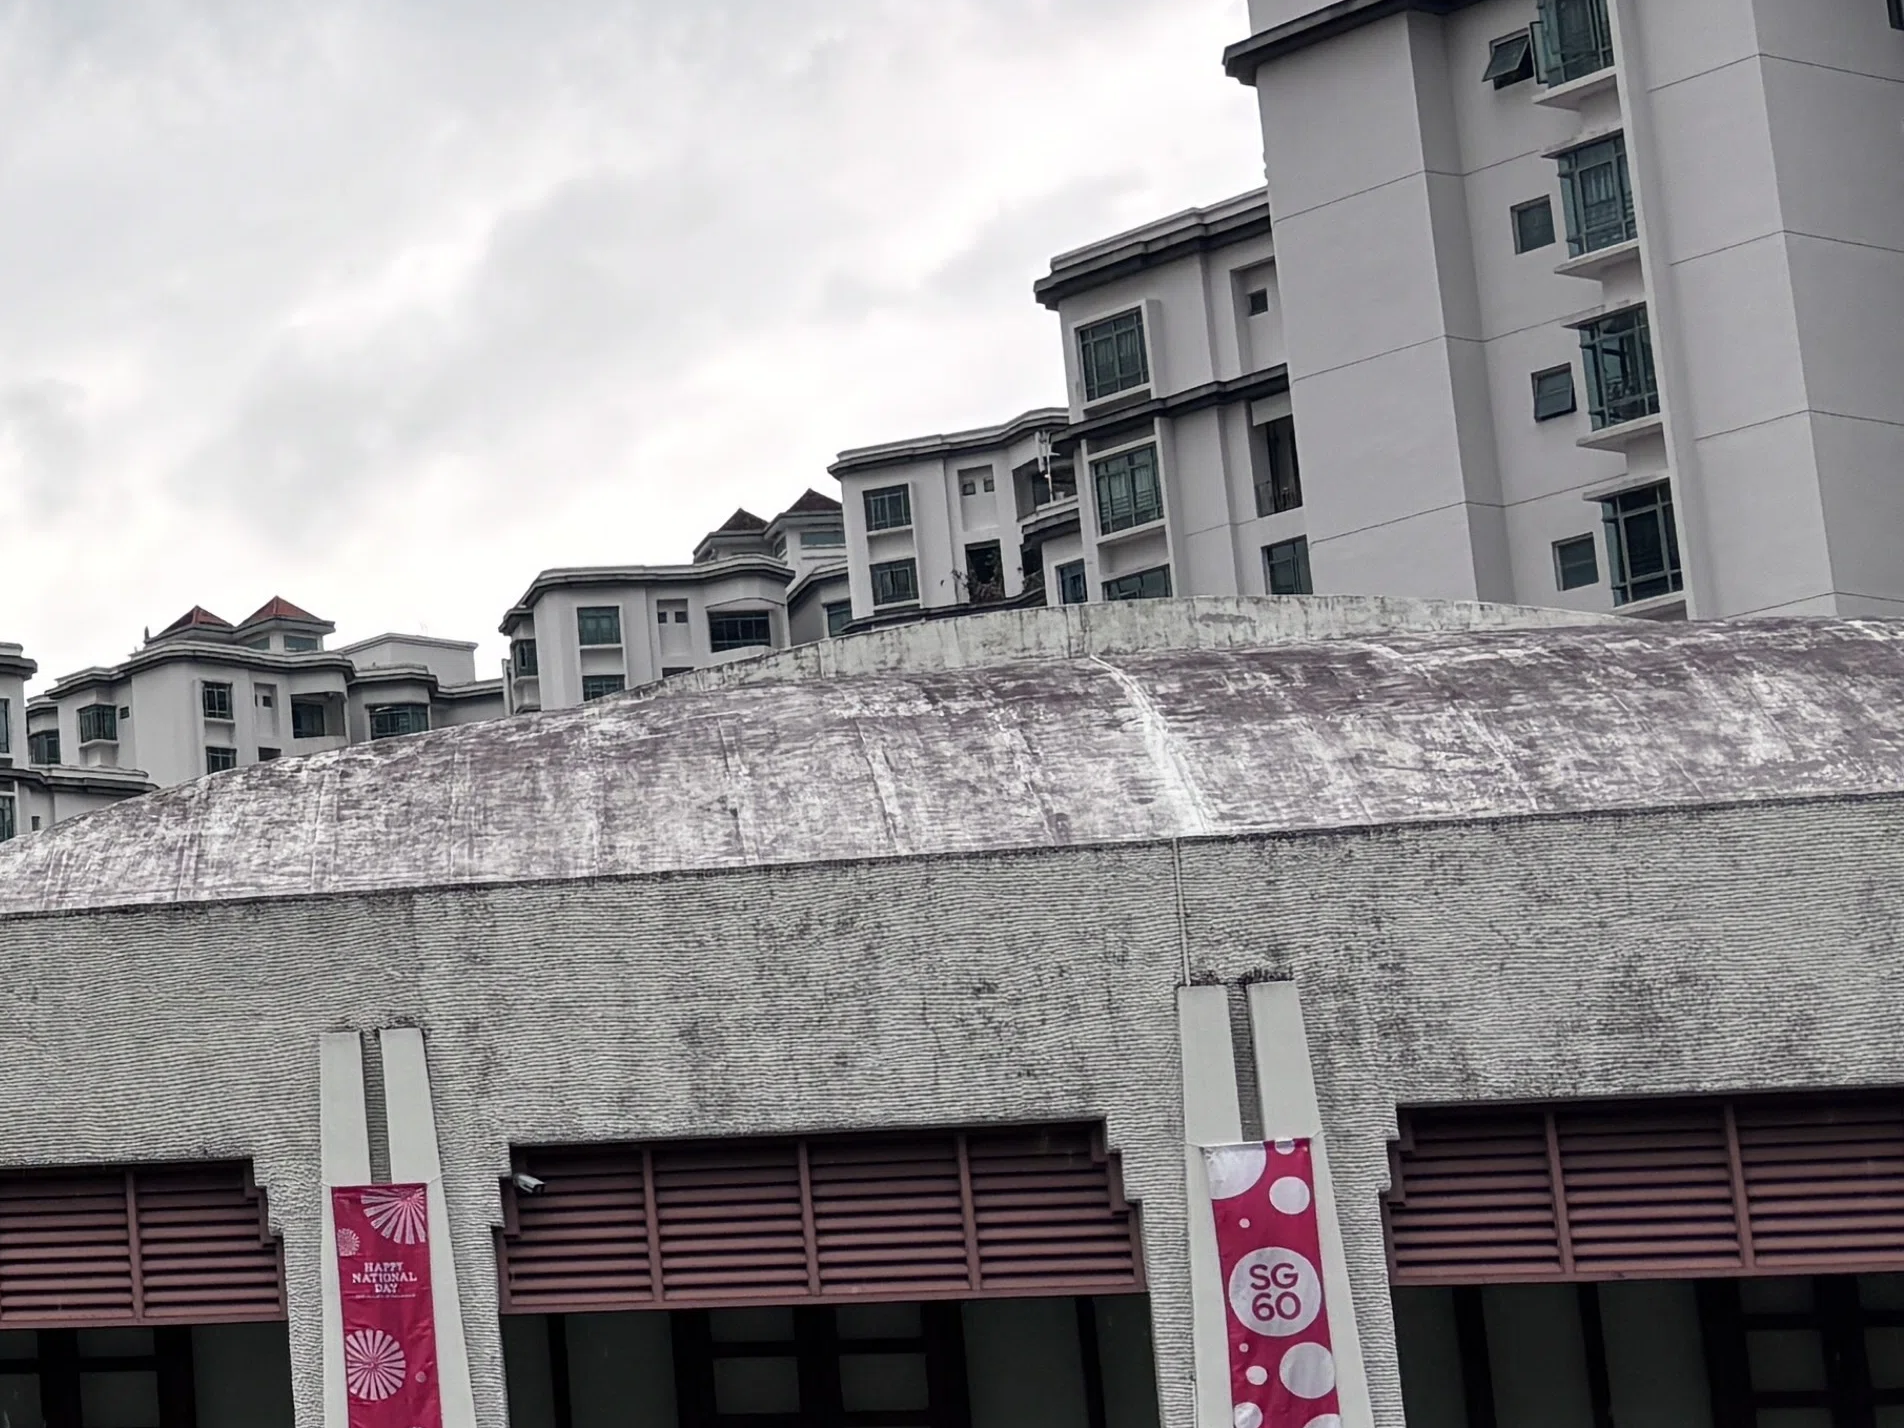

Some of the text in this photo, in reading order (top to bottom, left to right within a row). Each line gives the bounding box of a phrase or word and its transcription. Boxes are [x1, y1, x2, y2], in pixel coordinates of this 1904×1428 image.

[364, 1262, 403, 1272] HAPPY
[352, 1272, 417, 1283] NATIONAL
[1249, 1262, 1299, 1291] SG
[375, 1283, 397, 1293] DAY
[1252, 1291, 1302, 1322] 60
